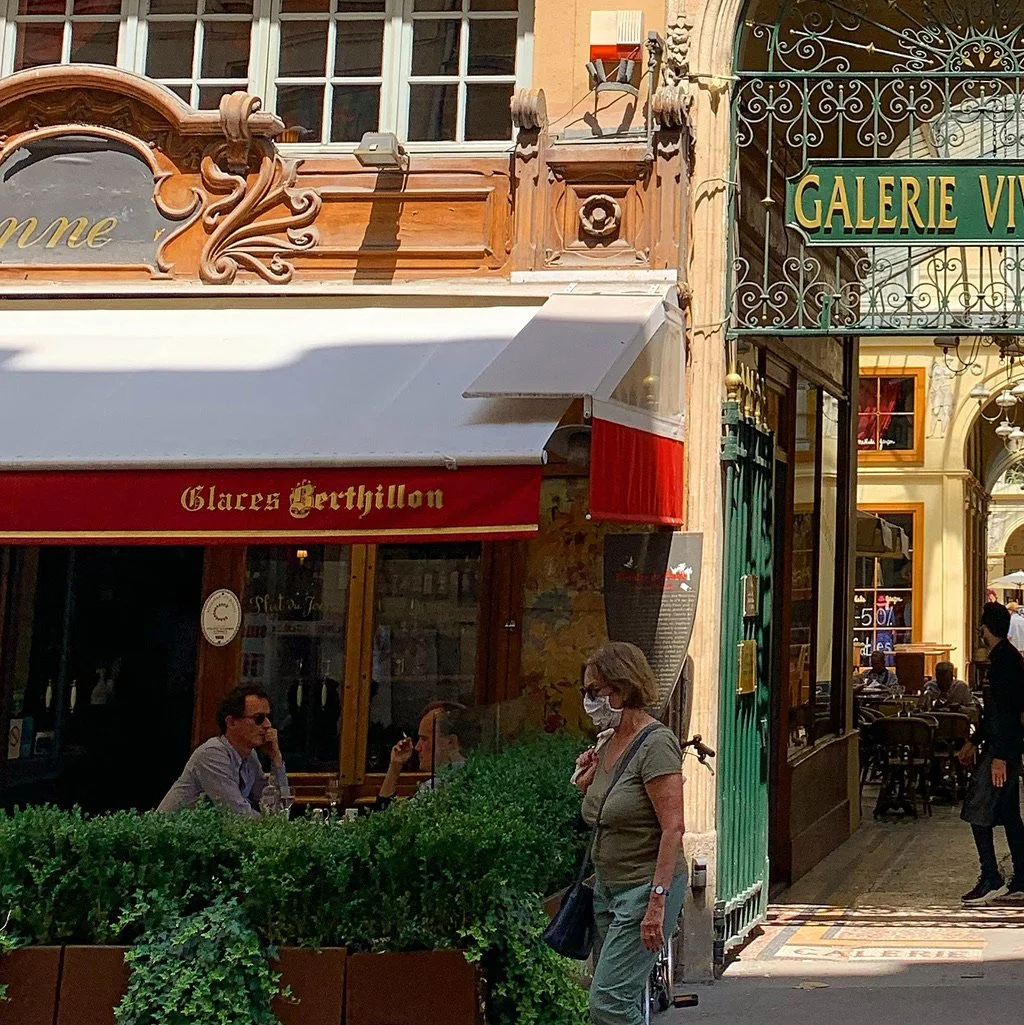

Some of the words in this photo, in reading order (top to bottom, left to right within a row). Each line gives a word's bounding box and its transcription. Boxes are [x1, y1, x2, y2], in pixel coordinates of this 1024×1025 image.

[794, 174, 958, 232] GALERIE
[180, 485, 281, 512] Glaces
[289, 479, 444, 519] Berthillon
